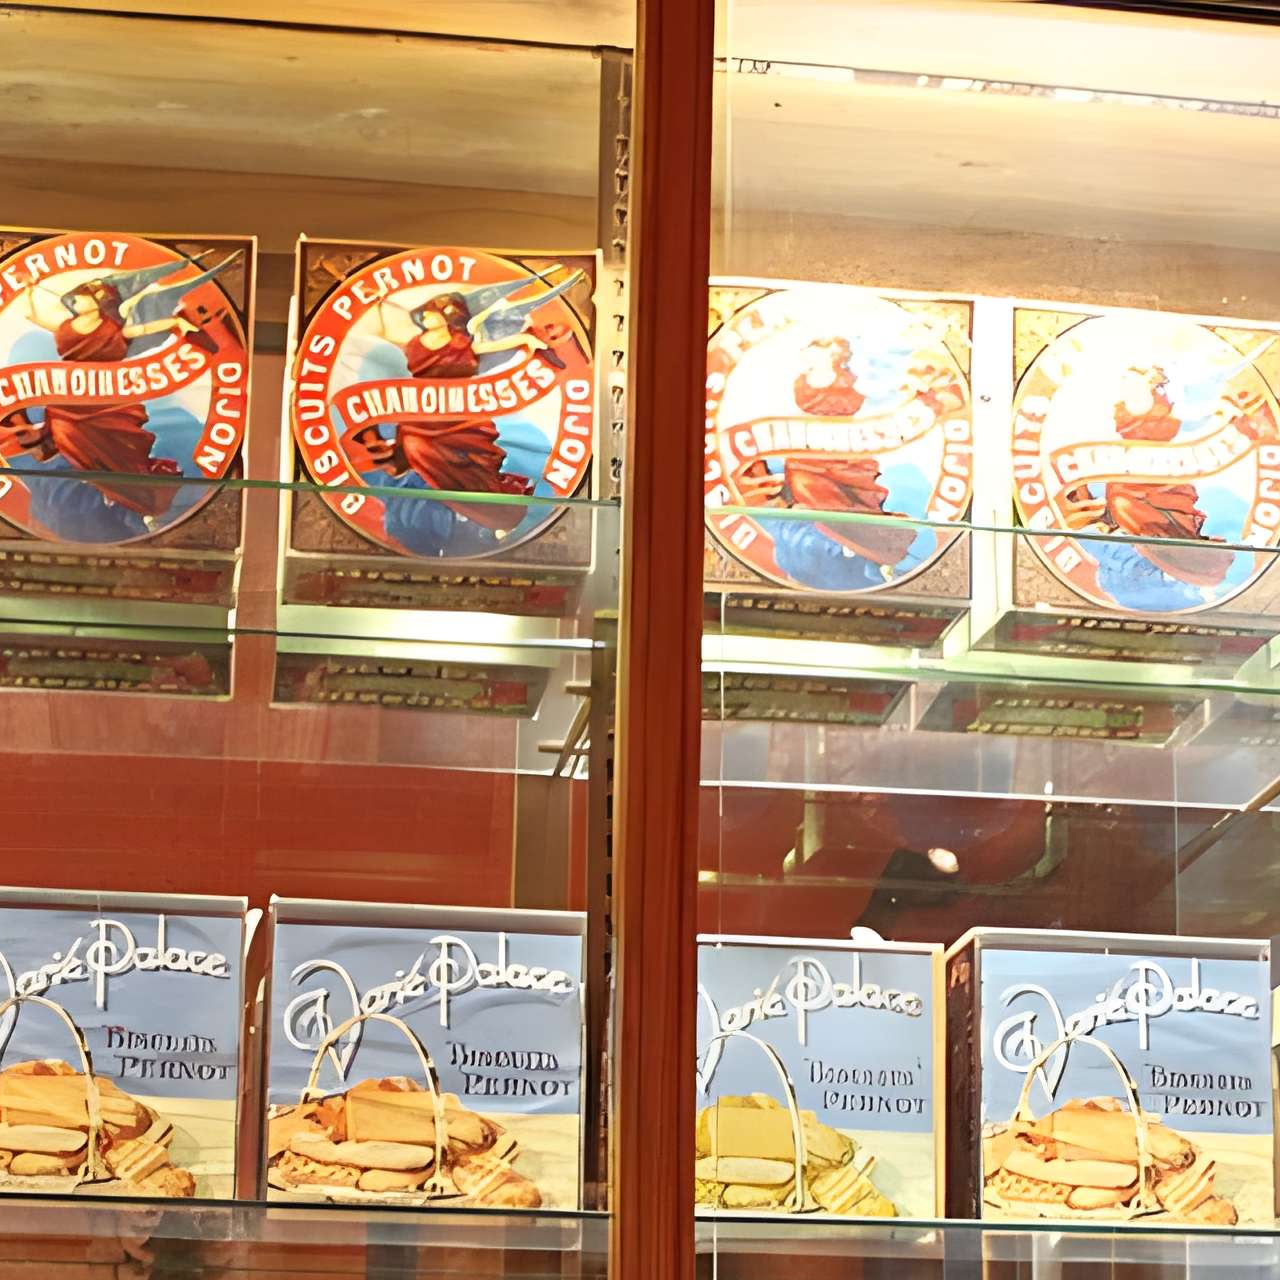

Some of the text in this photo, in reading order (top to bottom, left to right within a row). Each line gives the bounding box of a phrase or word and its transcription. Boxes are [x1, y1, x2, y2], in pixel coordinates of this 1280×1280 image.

[332, 253, 477, 320] PERNOT
[196, 361, 242, 473] DIJON
[546, 378, 592, 490] DIJON
